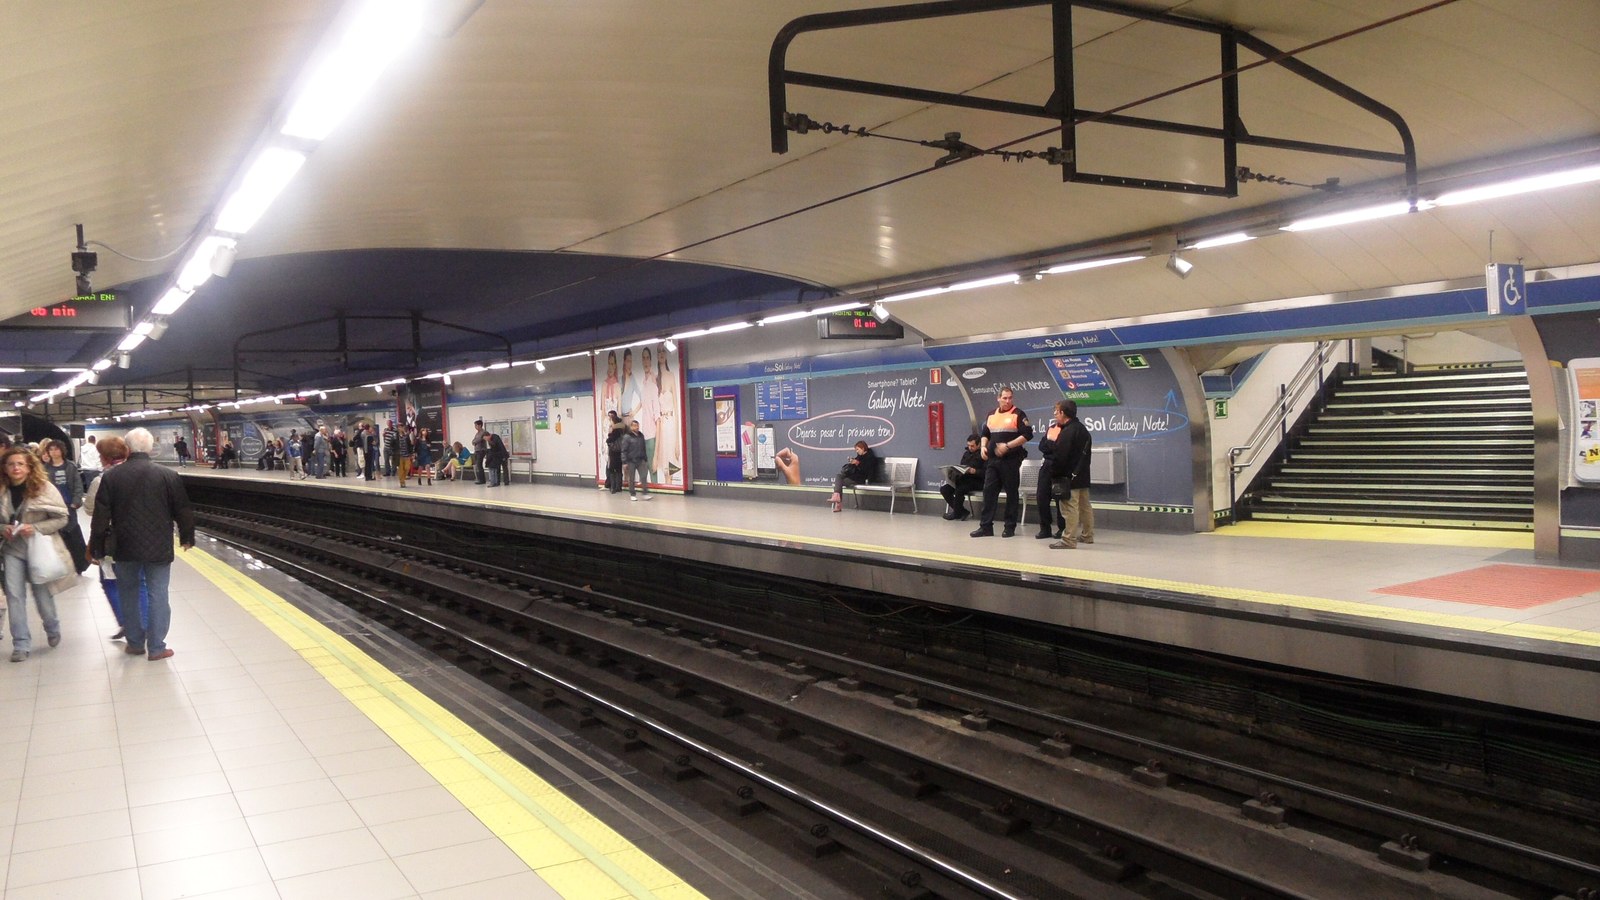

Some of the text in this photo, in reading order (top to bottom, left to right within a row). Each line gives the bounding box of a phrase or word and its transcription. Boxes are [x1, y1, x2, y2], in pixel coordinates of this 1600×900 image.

[52, 305, 76, 316] min
[1045, 338, 1066, 348] Sol
[867, 377, 918, 389] Smartphone? Tablet?
[970, 385, 996, 395] Samsung
[1027, 380, 1051, 390] Note
[867, 386, 928, 417] Galaxy Note!
[1066, 391, 1090, 399] Salida
[1084, 413, 1169, 438] Sol Galaxy Note!
[819, 428, 837, 444] pasar
[838, 423, 846, 438] el
[846, 425, 875, 444] próximo
[877, 424, 892, 437] tren
